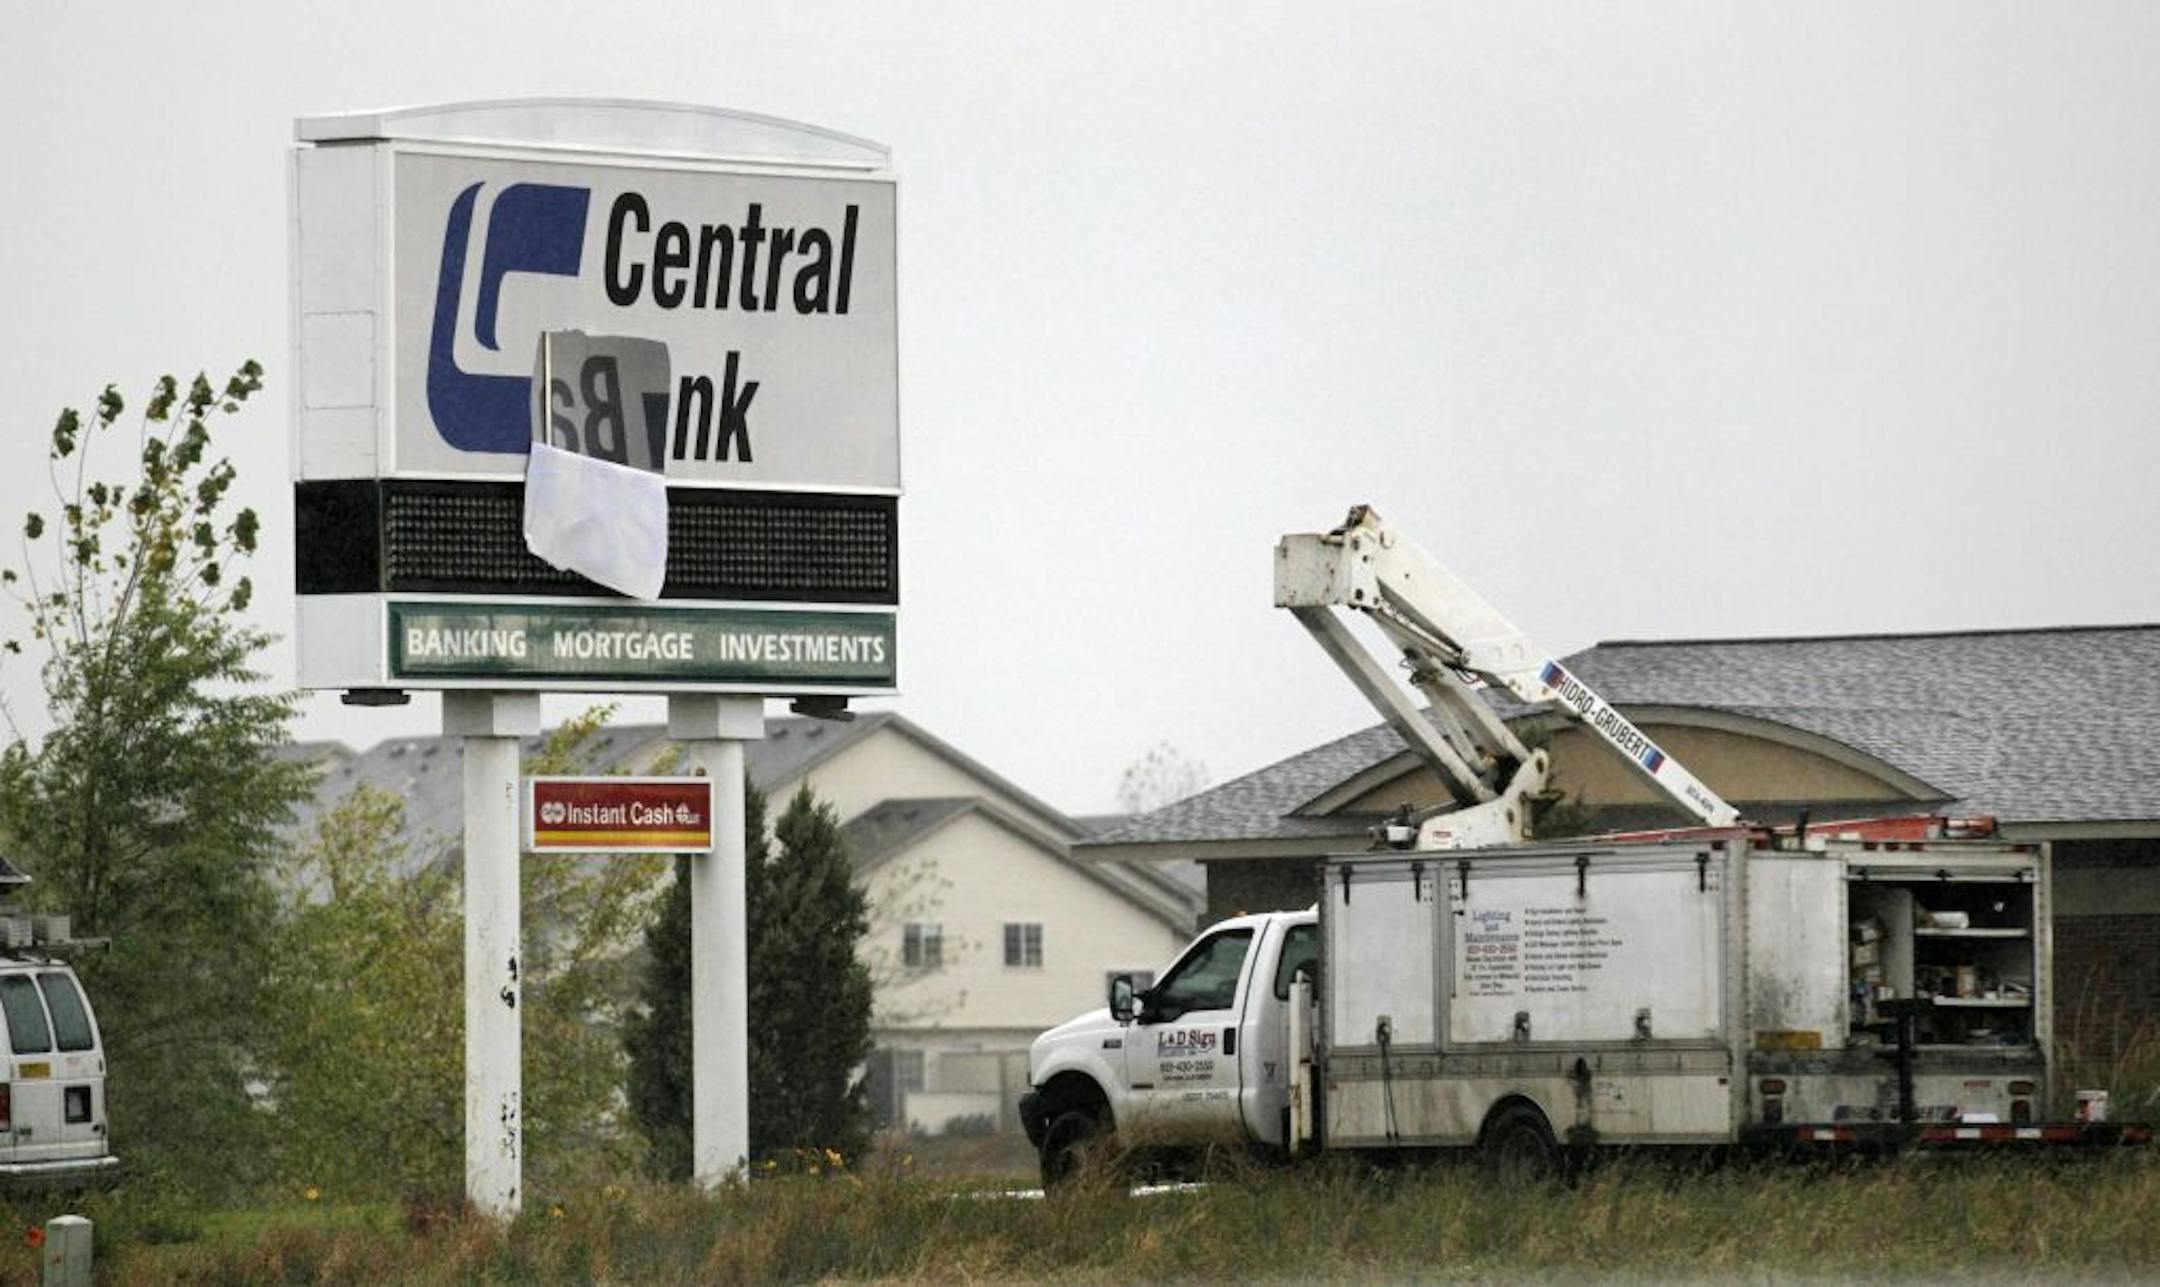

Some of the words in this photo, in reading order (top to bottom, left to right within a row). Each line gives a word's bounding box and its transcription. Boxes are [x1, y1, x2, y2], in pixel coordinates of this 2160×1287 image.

[603, 191, 859, 315] Central
[672, 350, 760, 463] nk
[407, 628, 527, 659] BANKING
[553, 631, 694, 661] MORTGAGE
[719, 633, 886, 664] INVESTMENTS
[567, 801, 626, 825] Instant
[630, 801, 674, 826] Cash
